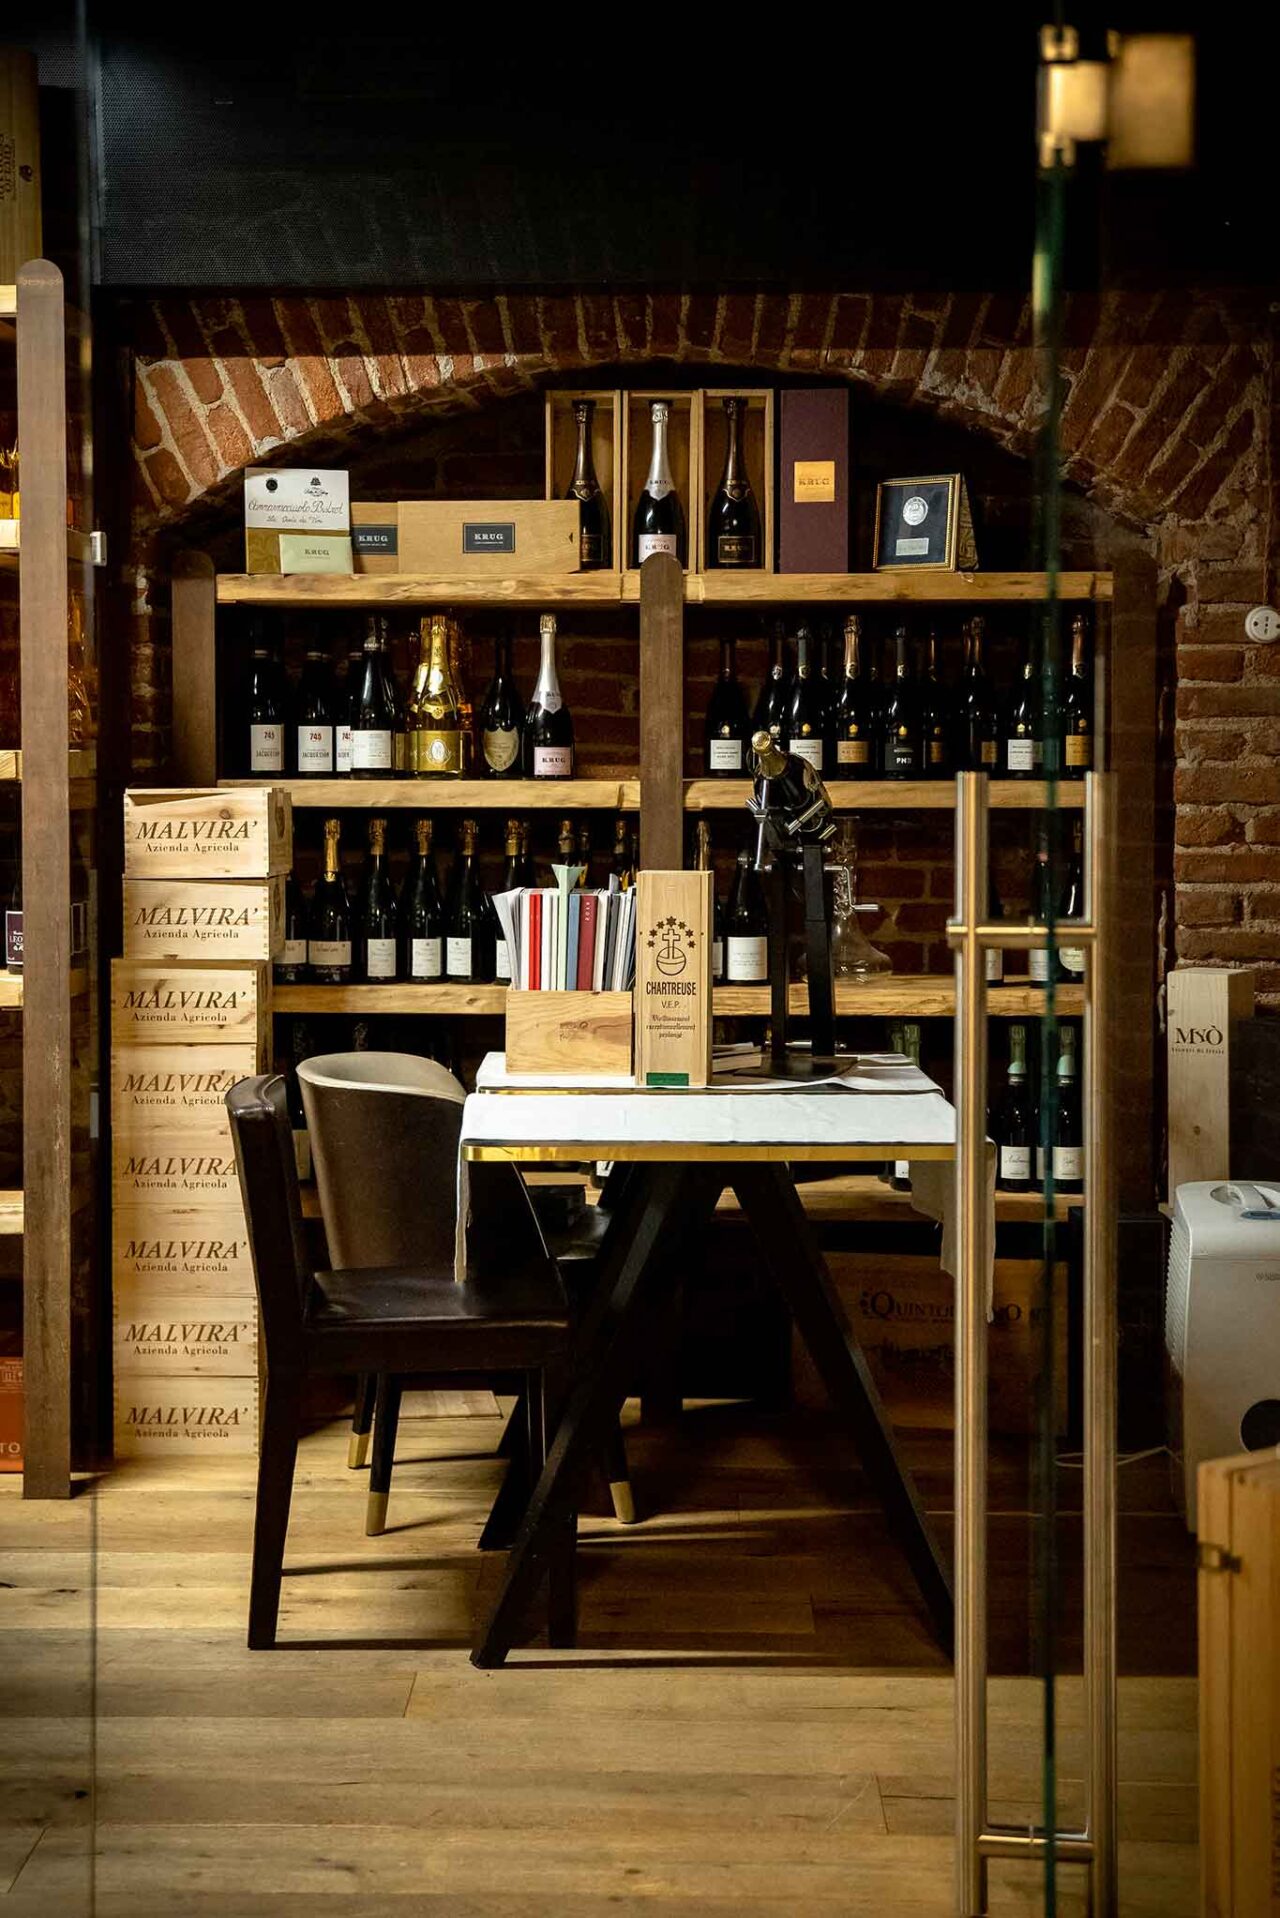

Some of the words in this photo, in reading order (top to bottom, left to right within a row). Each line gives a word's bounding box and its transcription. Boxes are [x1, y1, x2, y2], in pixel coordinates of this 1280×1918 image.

[798, 477, 830, 486] KRUG
[474, 533, 504, 541] KRUG
[304, 548, 330, 556] KRUG
[135, 820, 258, 840] MALVIRA'
[145, 842, 189, 852] Azienda
[193, 842, 239, 854] Agricola
[134, 906, 259, 926] MALVIRA'
[143, 929, 188, 938] Azienda
[192, 929, 239, 941] Agricola
[646, 981, 696, 996] CHARTREUSE
[122, 990, 246, 1009] MALVIRA'
[661, 1000, 681, 1009] V.E.P.
[131, 1012, 176, 1022] Azienda
[180, 1012, 227, 1024] Agricola
[132, 1095, 176, 1105] Azienda
[122, 1157, 238, 1176] MALVIRA
[132, 1179, 177, 1188] Azienda
[181, 1179, 228, 1190] Agricola
[124, 1240, 247, 1259] MALVIRA'
[133, 1262, 177, 1272] Azienda
[181, 1262, 228, 1274] Agricola
[124, 1324, 247, 1343] MALVIRA'
[133, 1345, 178, 1355] Azienda
[182, 1345, 229, 1358] Agricola
[125, 1407, 248, 1425] MALVIRA'
[134, 1428, 179, 1438] Azienda
[183, 1428, 229, 1441] Agricola
